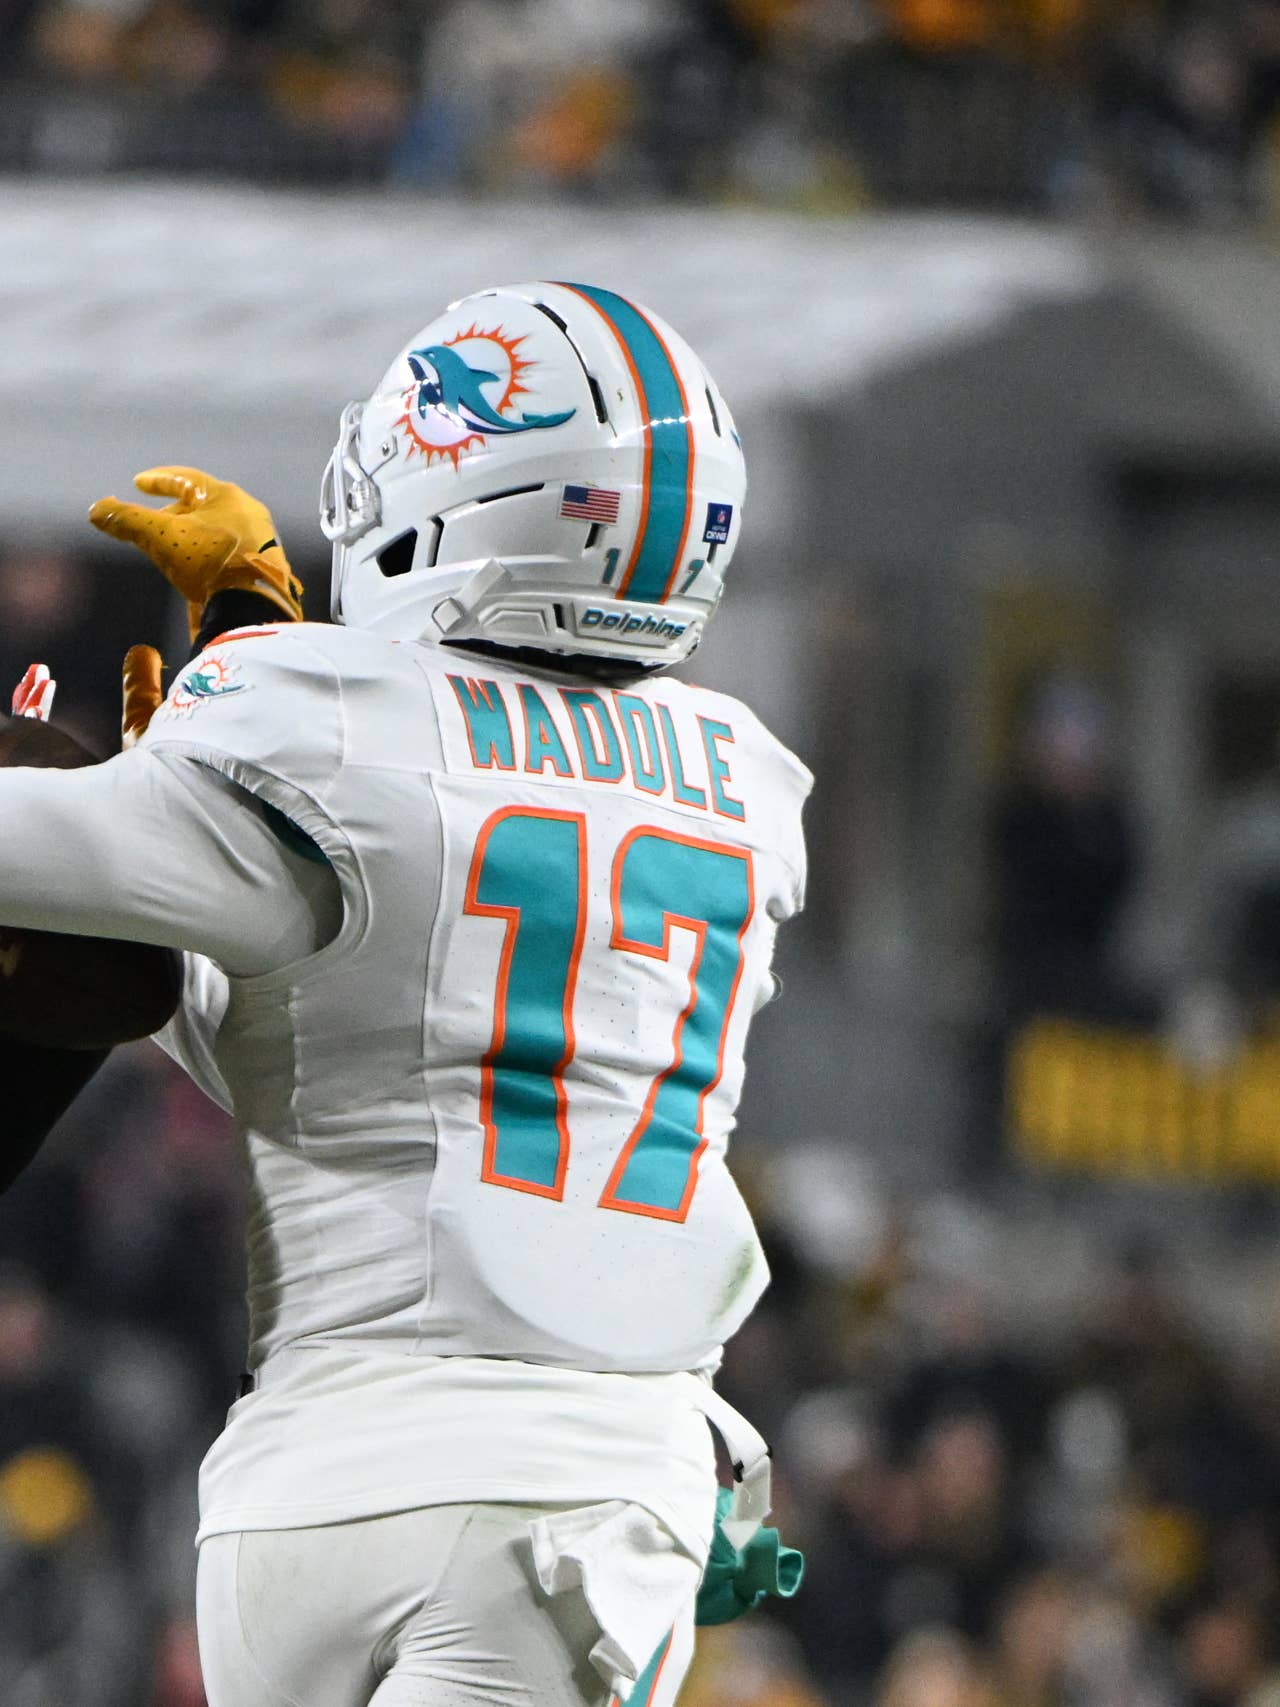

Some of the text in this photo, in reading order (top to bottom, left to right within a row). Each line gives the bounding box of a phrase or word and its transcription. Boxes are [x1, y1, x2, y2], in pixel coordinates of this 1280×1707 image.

[581, 608, 688, 639] Dolphins
[446, 673, 746, 822] WADDLE
[463, 805, 755, 1223] 17
